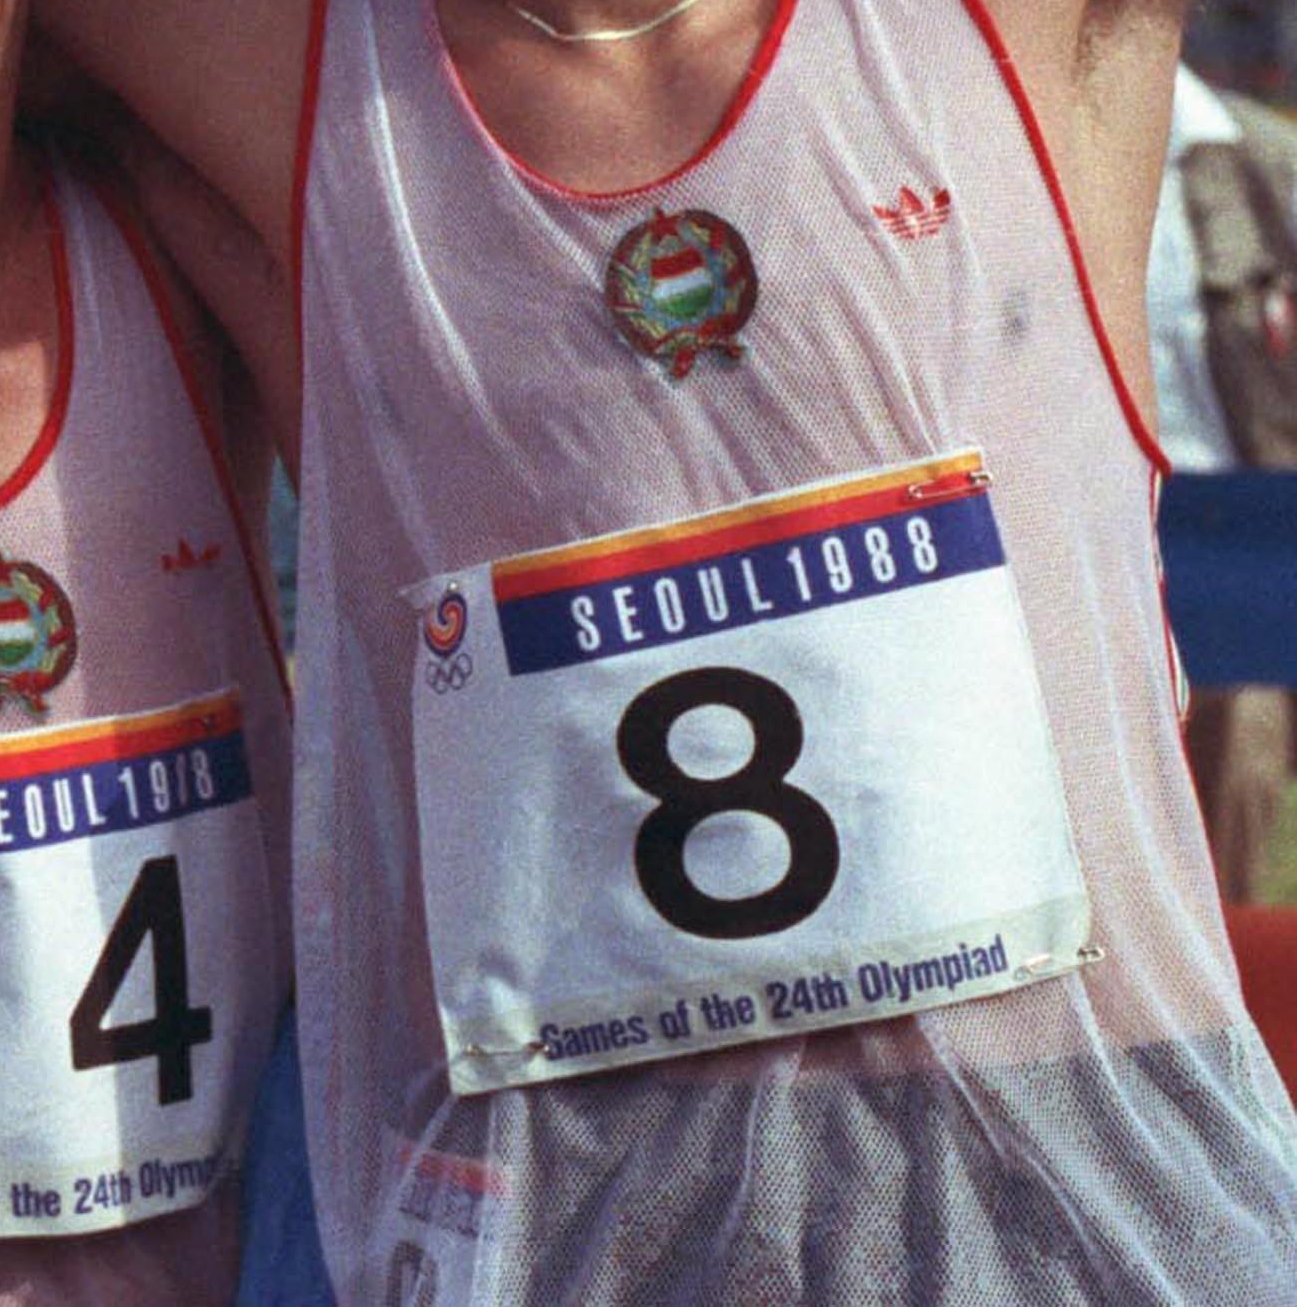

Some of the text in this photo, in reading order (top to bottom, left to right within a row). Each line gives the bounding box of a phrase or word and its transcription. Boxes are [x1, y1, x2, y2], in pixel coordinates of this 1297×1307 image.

[616, 666, 839, 940] 8
[541, 934, 1008, 1061] Games of the 24th Olympiad
[11, 1183, 61, 1219] the
[73, 1166, 134, 1215] 24th
